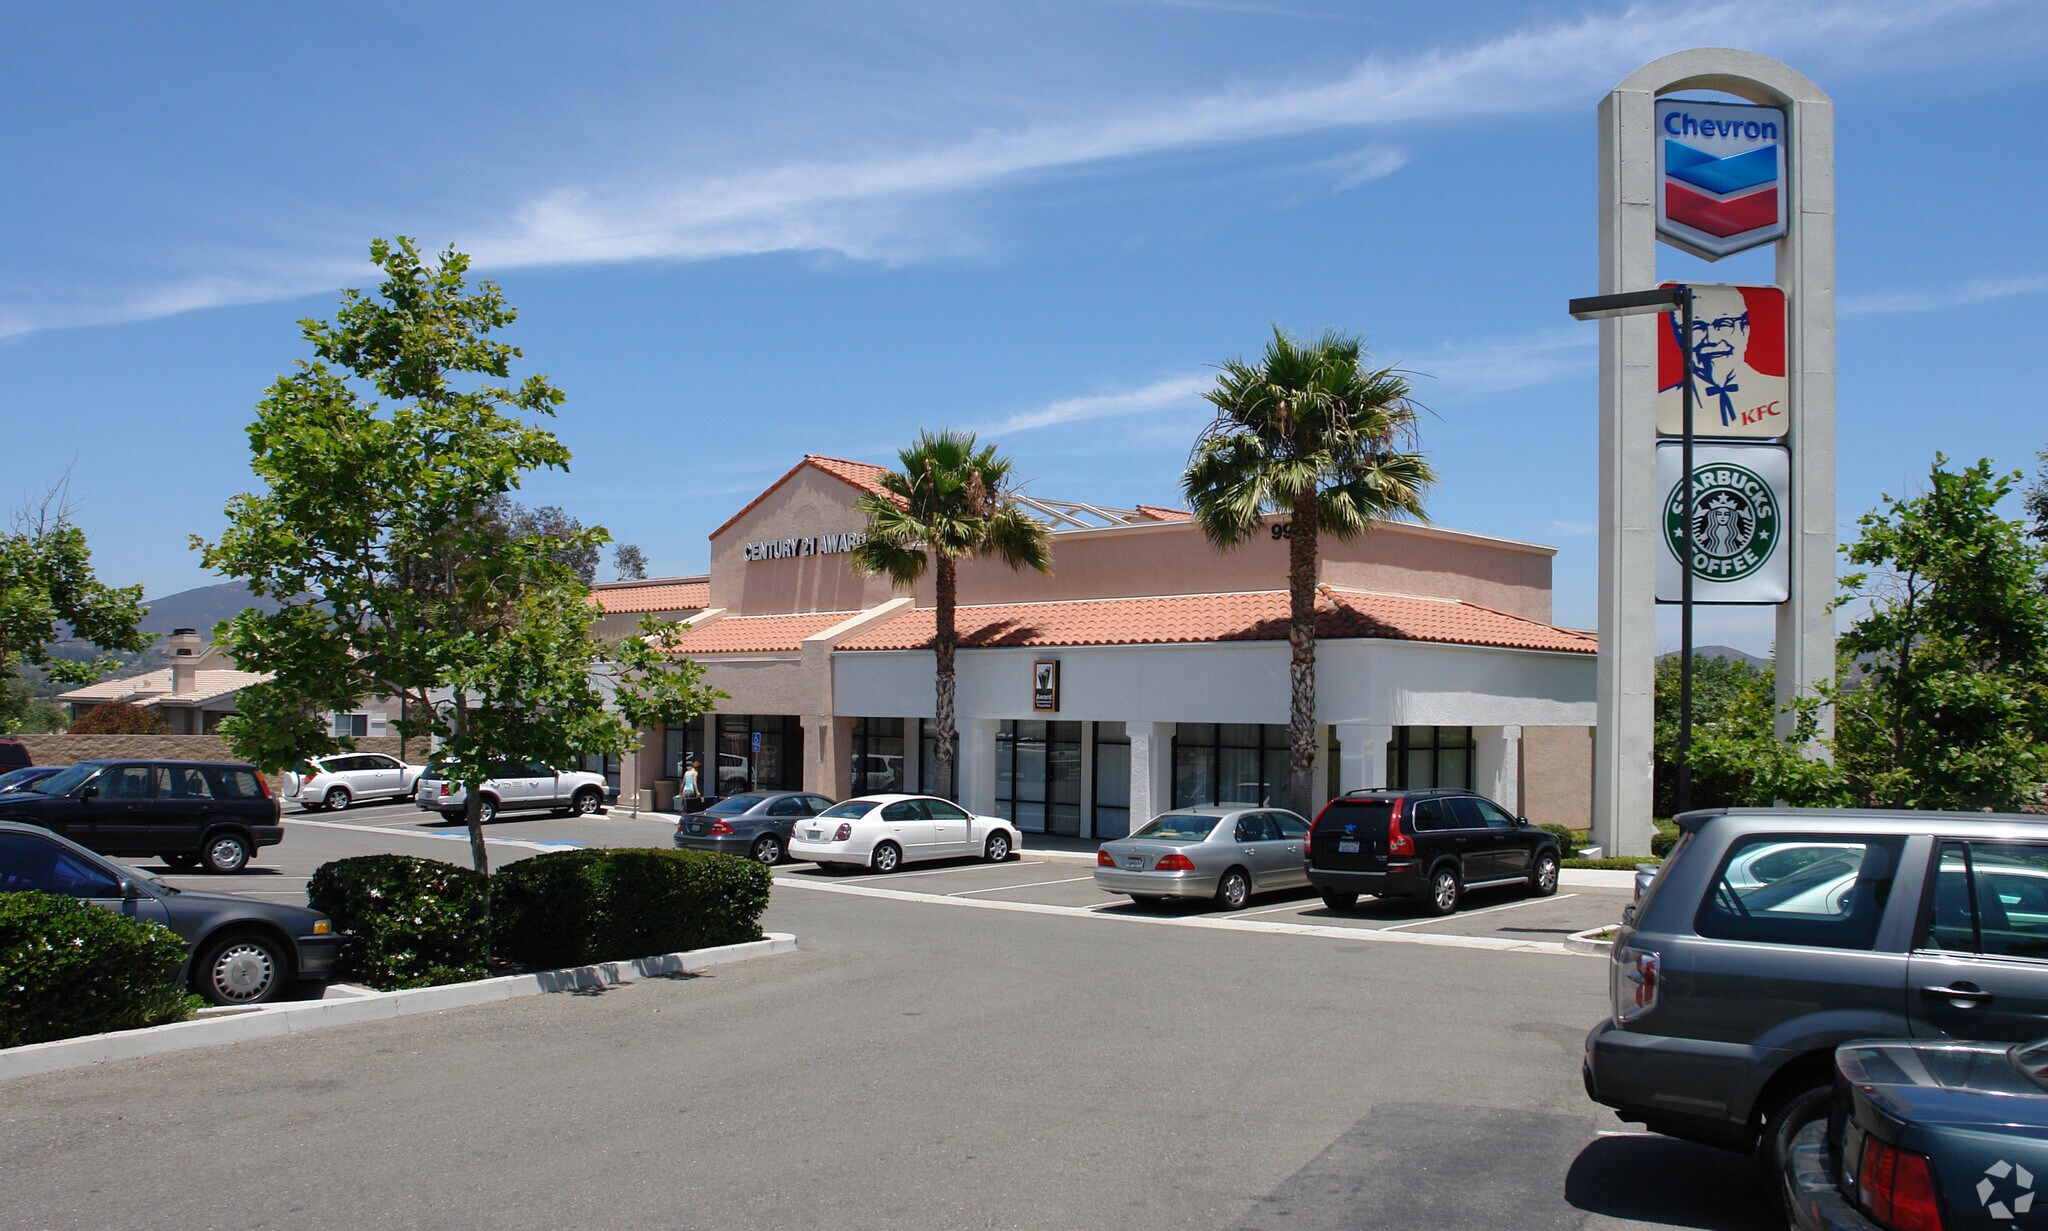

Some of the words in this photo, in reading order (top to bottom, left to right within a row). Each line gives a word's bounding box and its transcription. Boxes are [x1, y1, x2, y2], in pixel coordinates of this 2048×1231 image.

[1664, 111, 1778, 139] Chevron
[1740, 400, 1781, 426] KFC
[743, 538, 799, 561] CENTURY
[801, 536, 816, 556] 21
